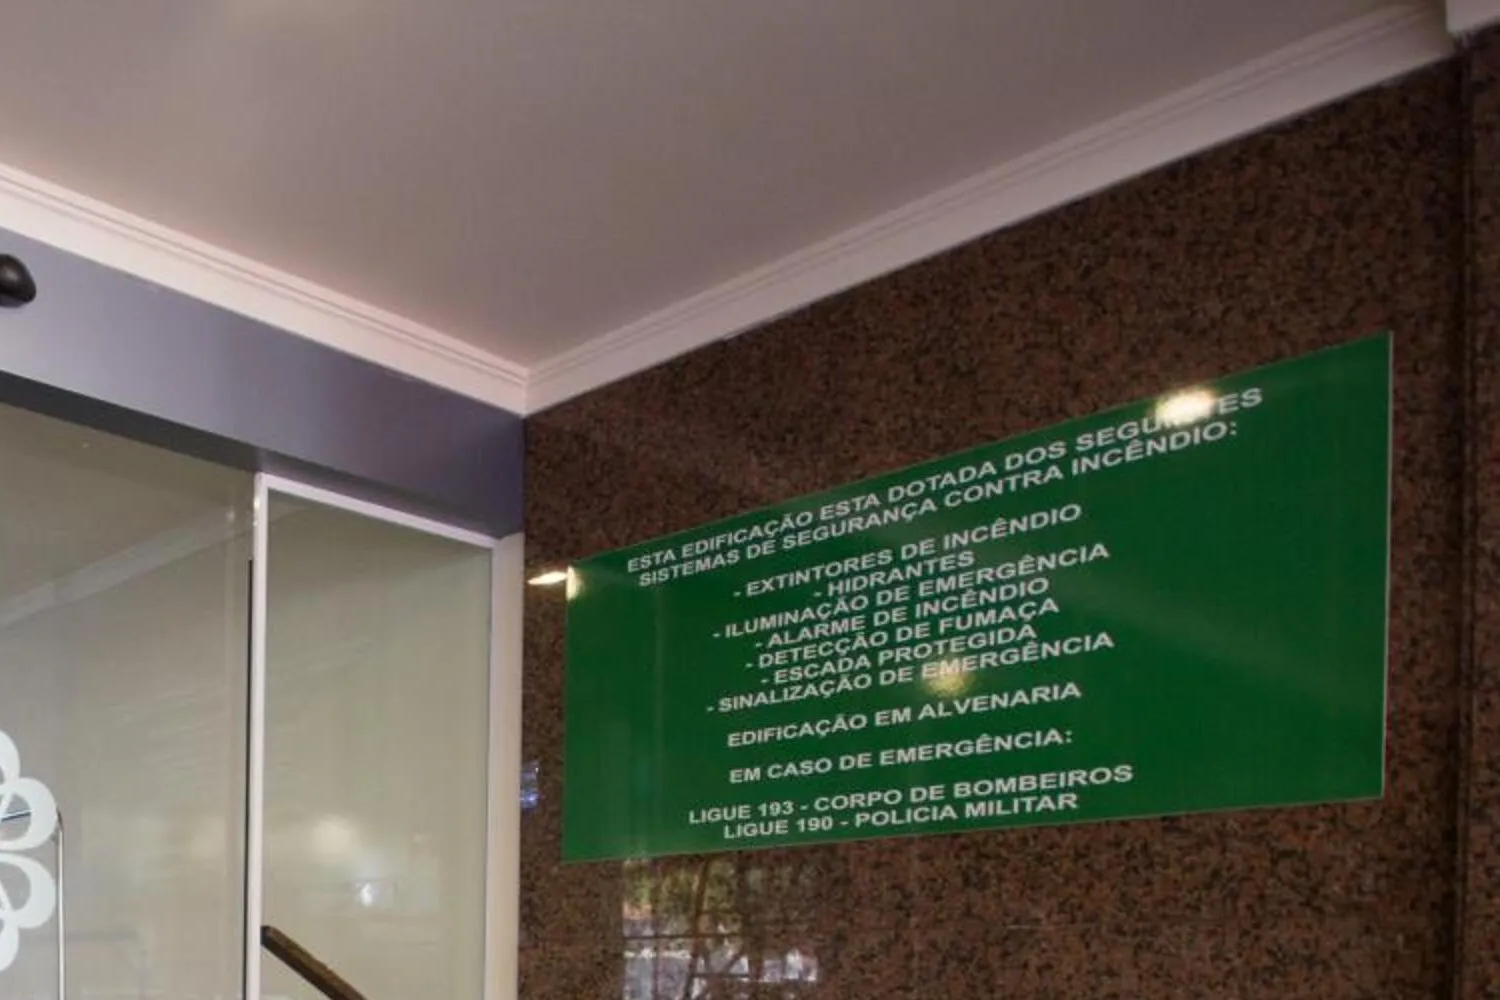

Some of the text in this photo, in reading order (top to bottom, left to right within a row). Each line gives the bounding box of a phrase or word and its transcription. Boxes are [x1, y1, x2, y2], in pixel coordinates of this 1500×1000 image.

[627, 387, 1263, 573] ESTA EDIFICAÇÃO ESTA DOTADA DOS SEGUES
[639, 420, 1237, 587] SISTEMAS DE SEGURANÇA CONTRA INCÊNDIO:
[746, 549, 893, 597] EXTINTORES
[900, 538, 935, 560] DE
[943, 503, 1082, 550] INCÊNDIO
[827, 550, 975, 597] HIDRANTES
[725, 594, 869, 638] ILUMINAÇÃO
[876, 585, 910, 606] DE
[918, 542, 1110, 597] EMERGÊNCIA
[767, 615, 866, 648] ALARME
[873, 606, 908, 627] DE
[915, 577, 1049, 619] INCÊNDIO
[758, 631, 888, 669] DETECÇÃO
[896, 622, 931, 643] DE
[939, 598, 1059, 635] FUMAÇA
[774, 654, 871, 684] ESCADA
[878, 624, 1038, 666] PROTEGIDA
[718, 673, 872, 713] SINALIZAÇÃO
[879, 666, 913, 686] DE
[921, 631, 1115, 679] EMERGÊNCIA
[727, 681, 1082, 747] EDIFICAÇÃO EM ALVENARIA
[729, 728, 1072, 784] EM CASO DE EMERGÊNCIA:
[689, 805, 751, 824] LIGUE
[757, 801, 794, 818] 193
[814, 789, 902, 812] CORPO
[910, 785, 945, 802] DE
[953, 764, 1134, 798] BOMBEIROS
[723, 819, 789, 839] LIGUE
[796, 816, 833, 833] 190
[855, 804, 958, 828] POLICIA
[965, 793, 1078, 819] MILITAR
